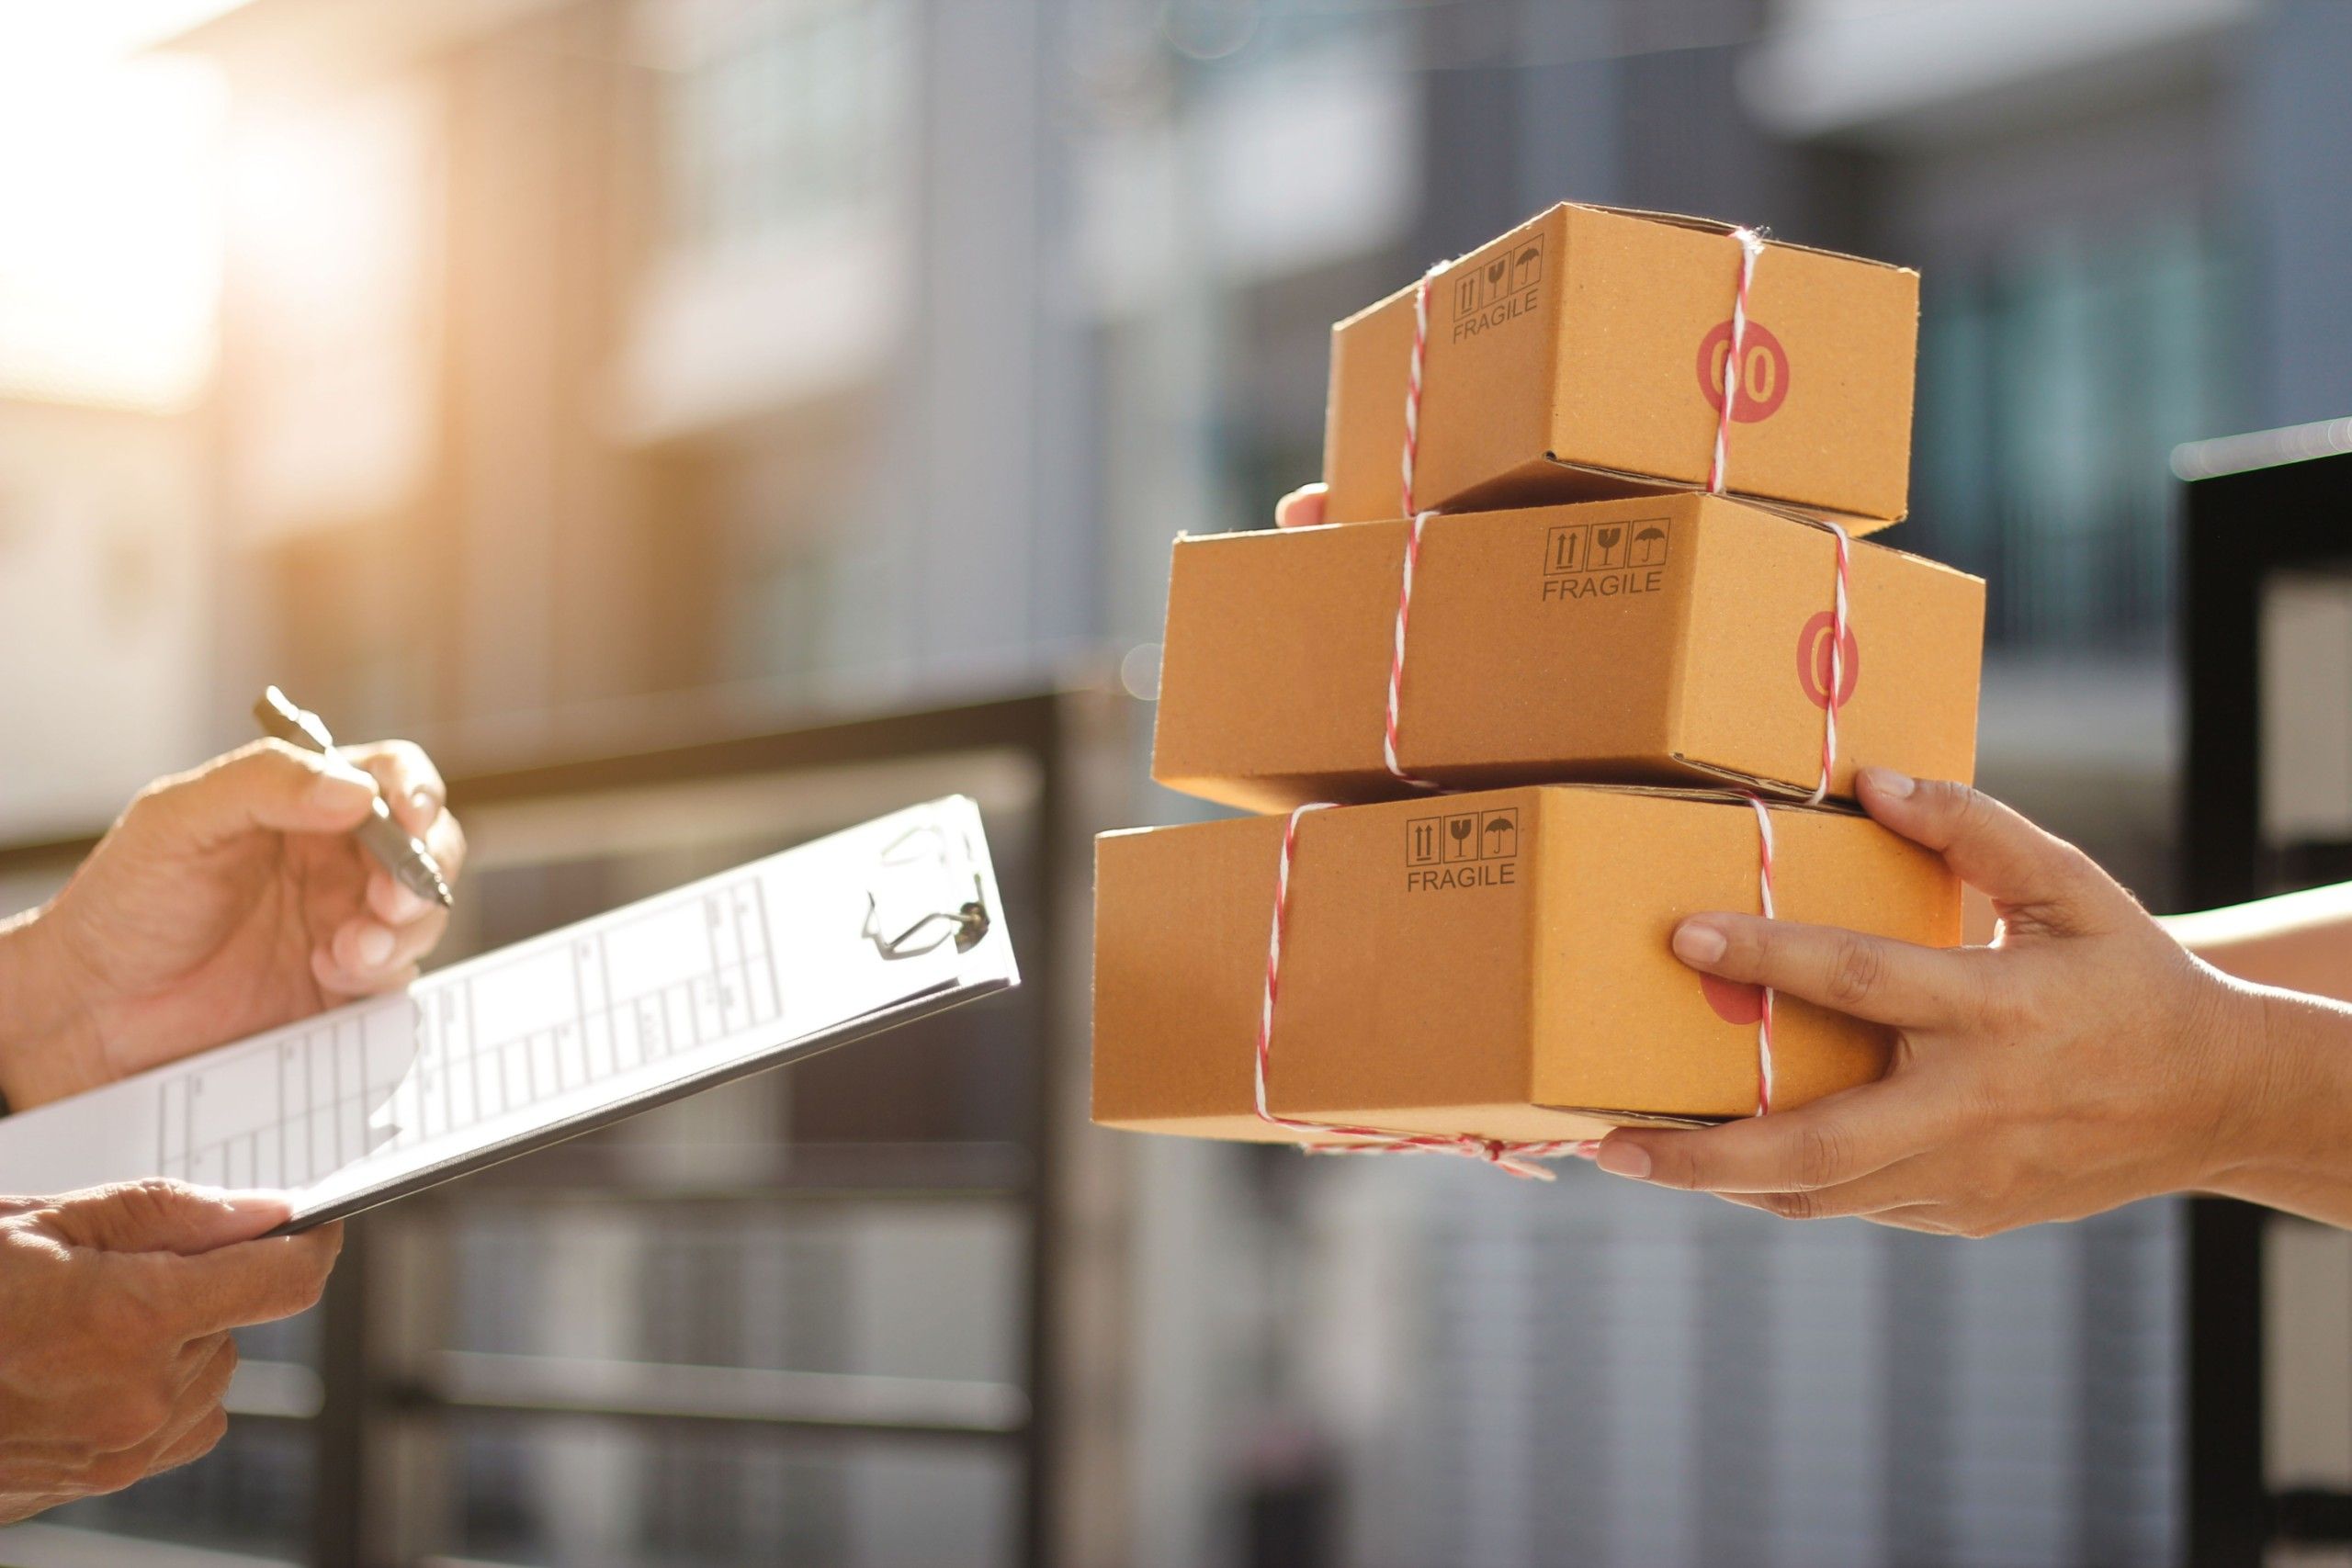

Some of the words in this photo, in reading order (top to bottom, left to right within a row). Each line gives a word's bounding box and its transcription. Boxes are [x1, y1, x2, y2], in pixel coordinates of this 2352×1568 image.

[1453, 288, 1539, 344] FRAGILE
[1542, 570, 1663, 602] FRAGILE
[1407, 863, 1515, 893] FRAGILE
